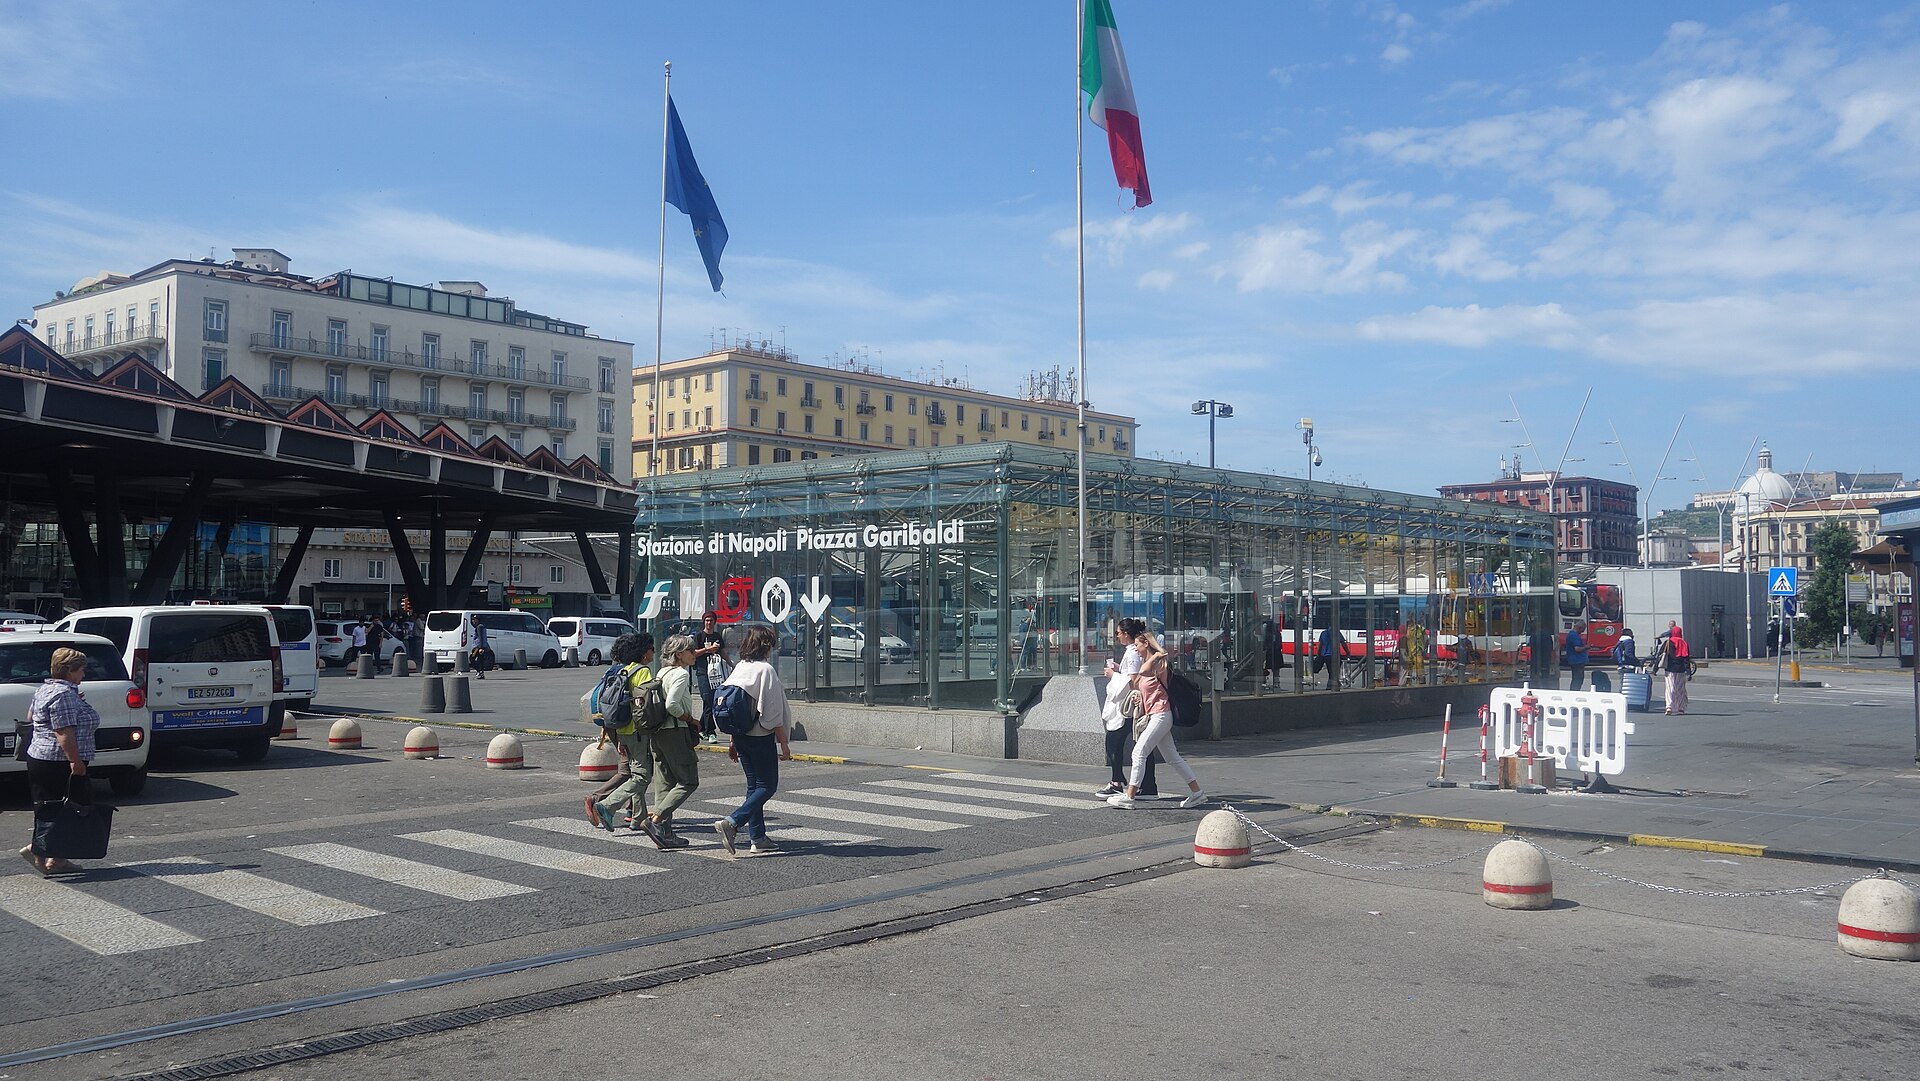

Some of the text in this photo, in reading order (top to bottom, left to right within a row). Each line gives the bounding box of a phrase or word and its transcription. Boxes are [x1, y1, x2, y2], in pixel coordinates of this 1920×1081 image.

[637, 519, 965, 557] Stazione di Napoli Piazza Garibaldi
